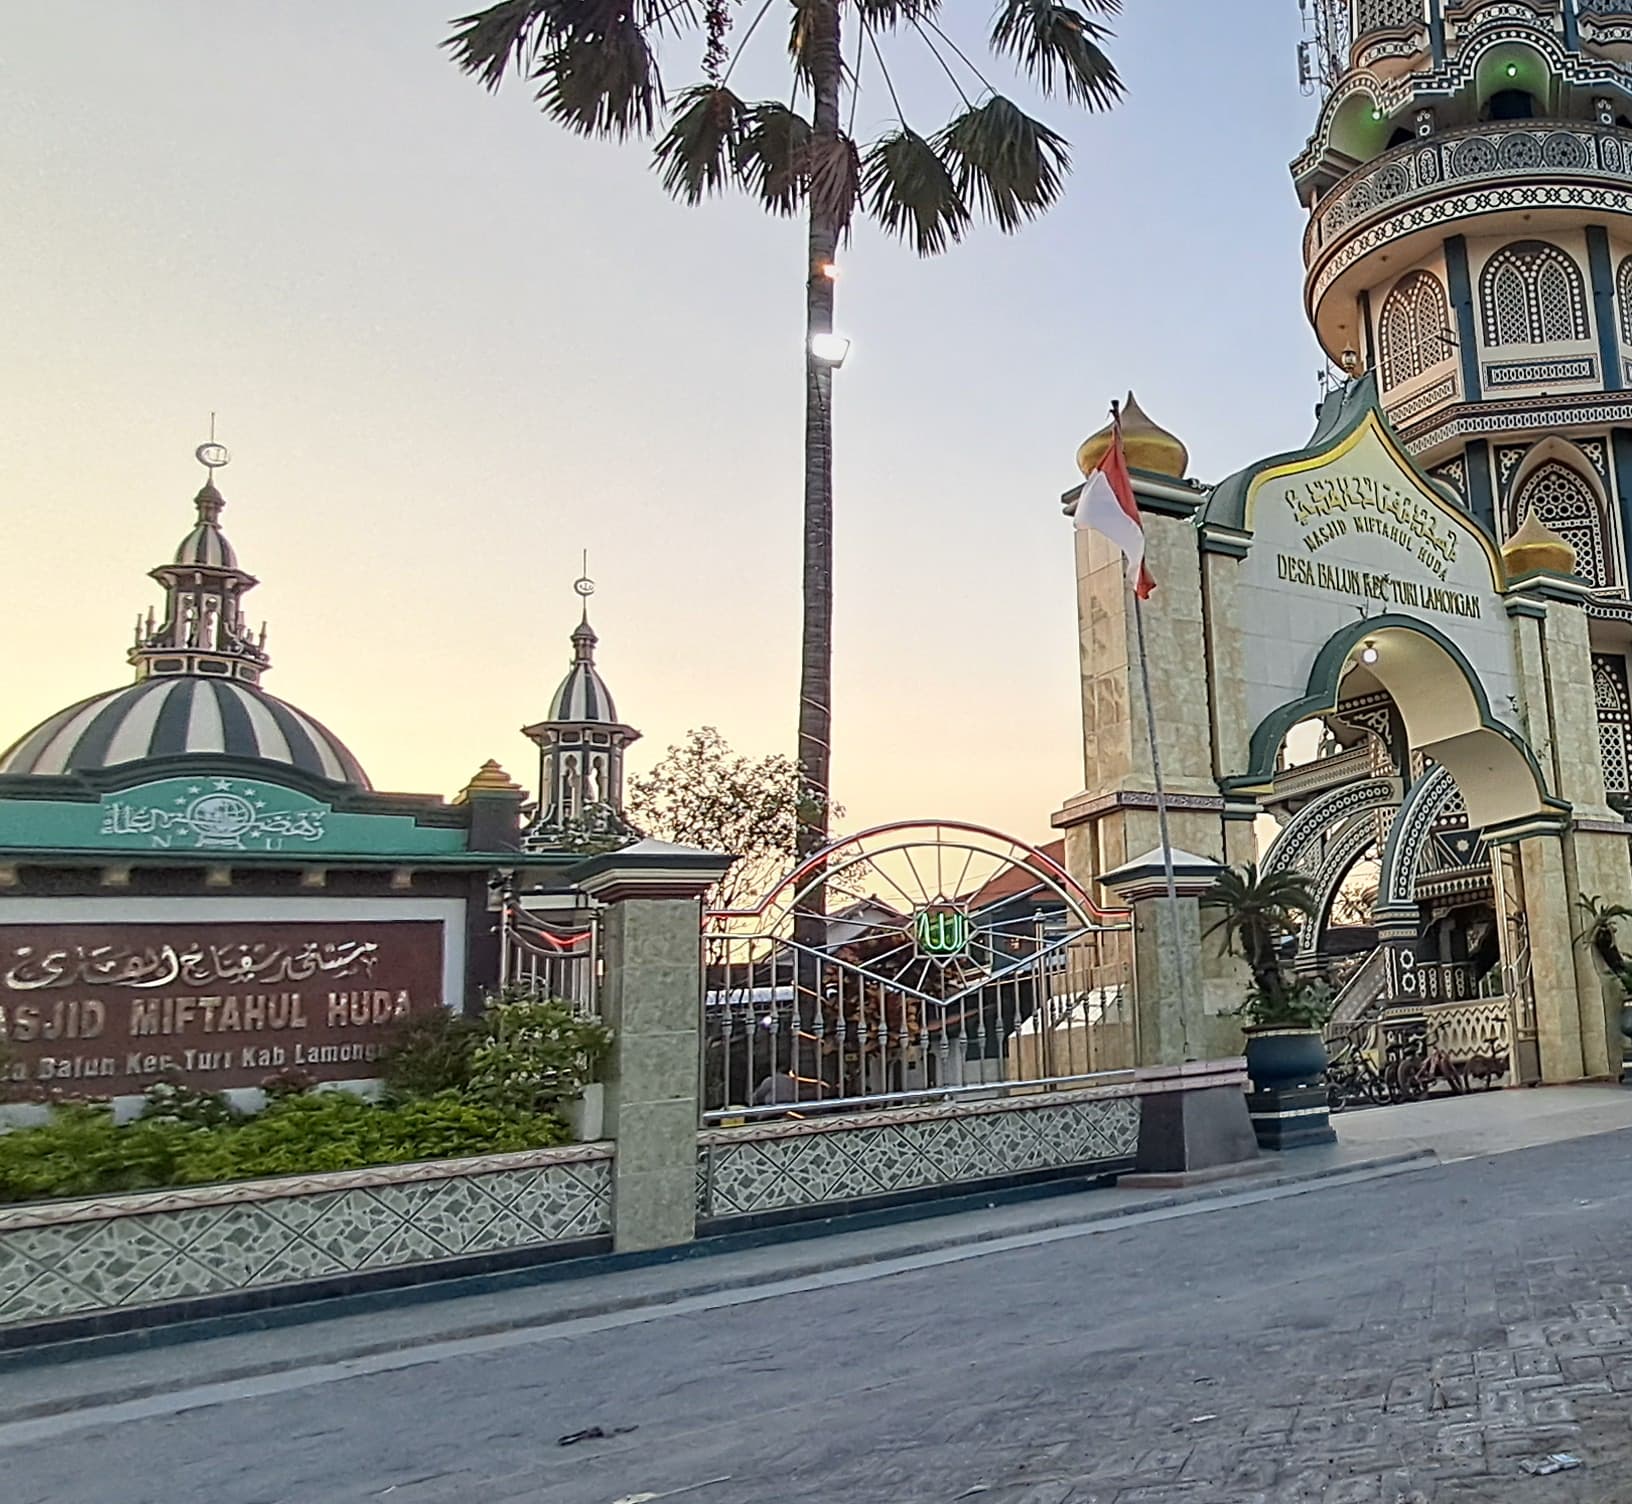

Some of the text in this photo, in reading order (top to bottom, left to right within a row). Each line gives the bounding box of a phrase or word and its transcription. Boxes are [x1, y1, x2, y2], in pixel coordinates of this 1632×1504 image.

[1303, 516, 1448, 582] MASJID MIFTAHUL HUDA
[1277, 554, 1315, 587] DESA
[1318, 562, 1360, 596] BALUN
[1391, 579, 1418, 607] TURI
[1420, 585, 1481, 619] LAMONGAN
[152, 835, 283, 850] N U
[0, 989, 411, 1041] SJID MIFTAHUL HUDA
[184, 1049, 232, 1070] Turi
[241, 1046, 286, 1068] Kab
